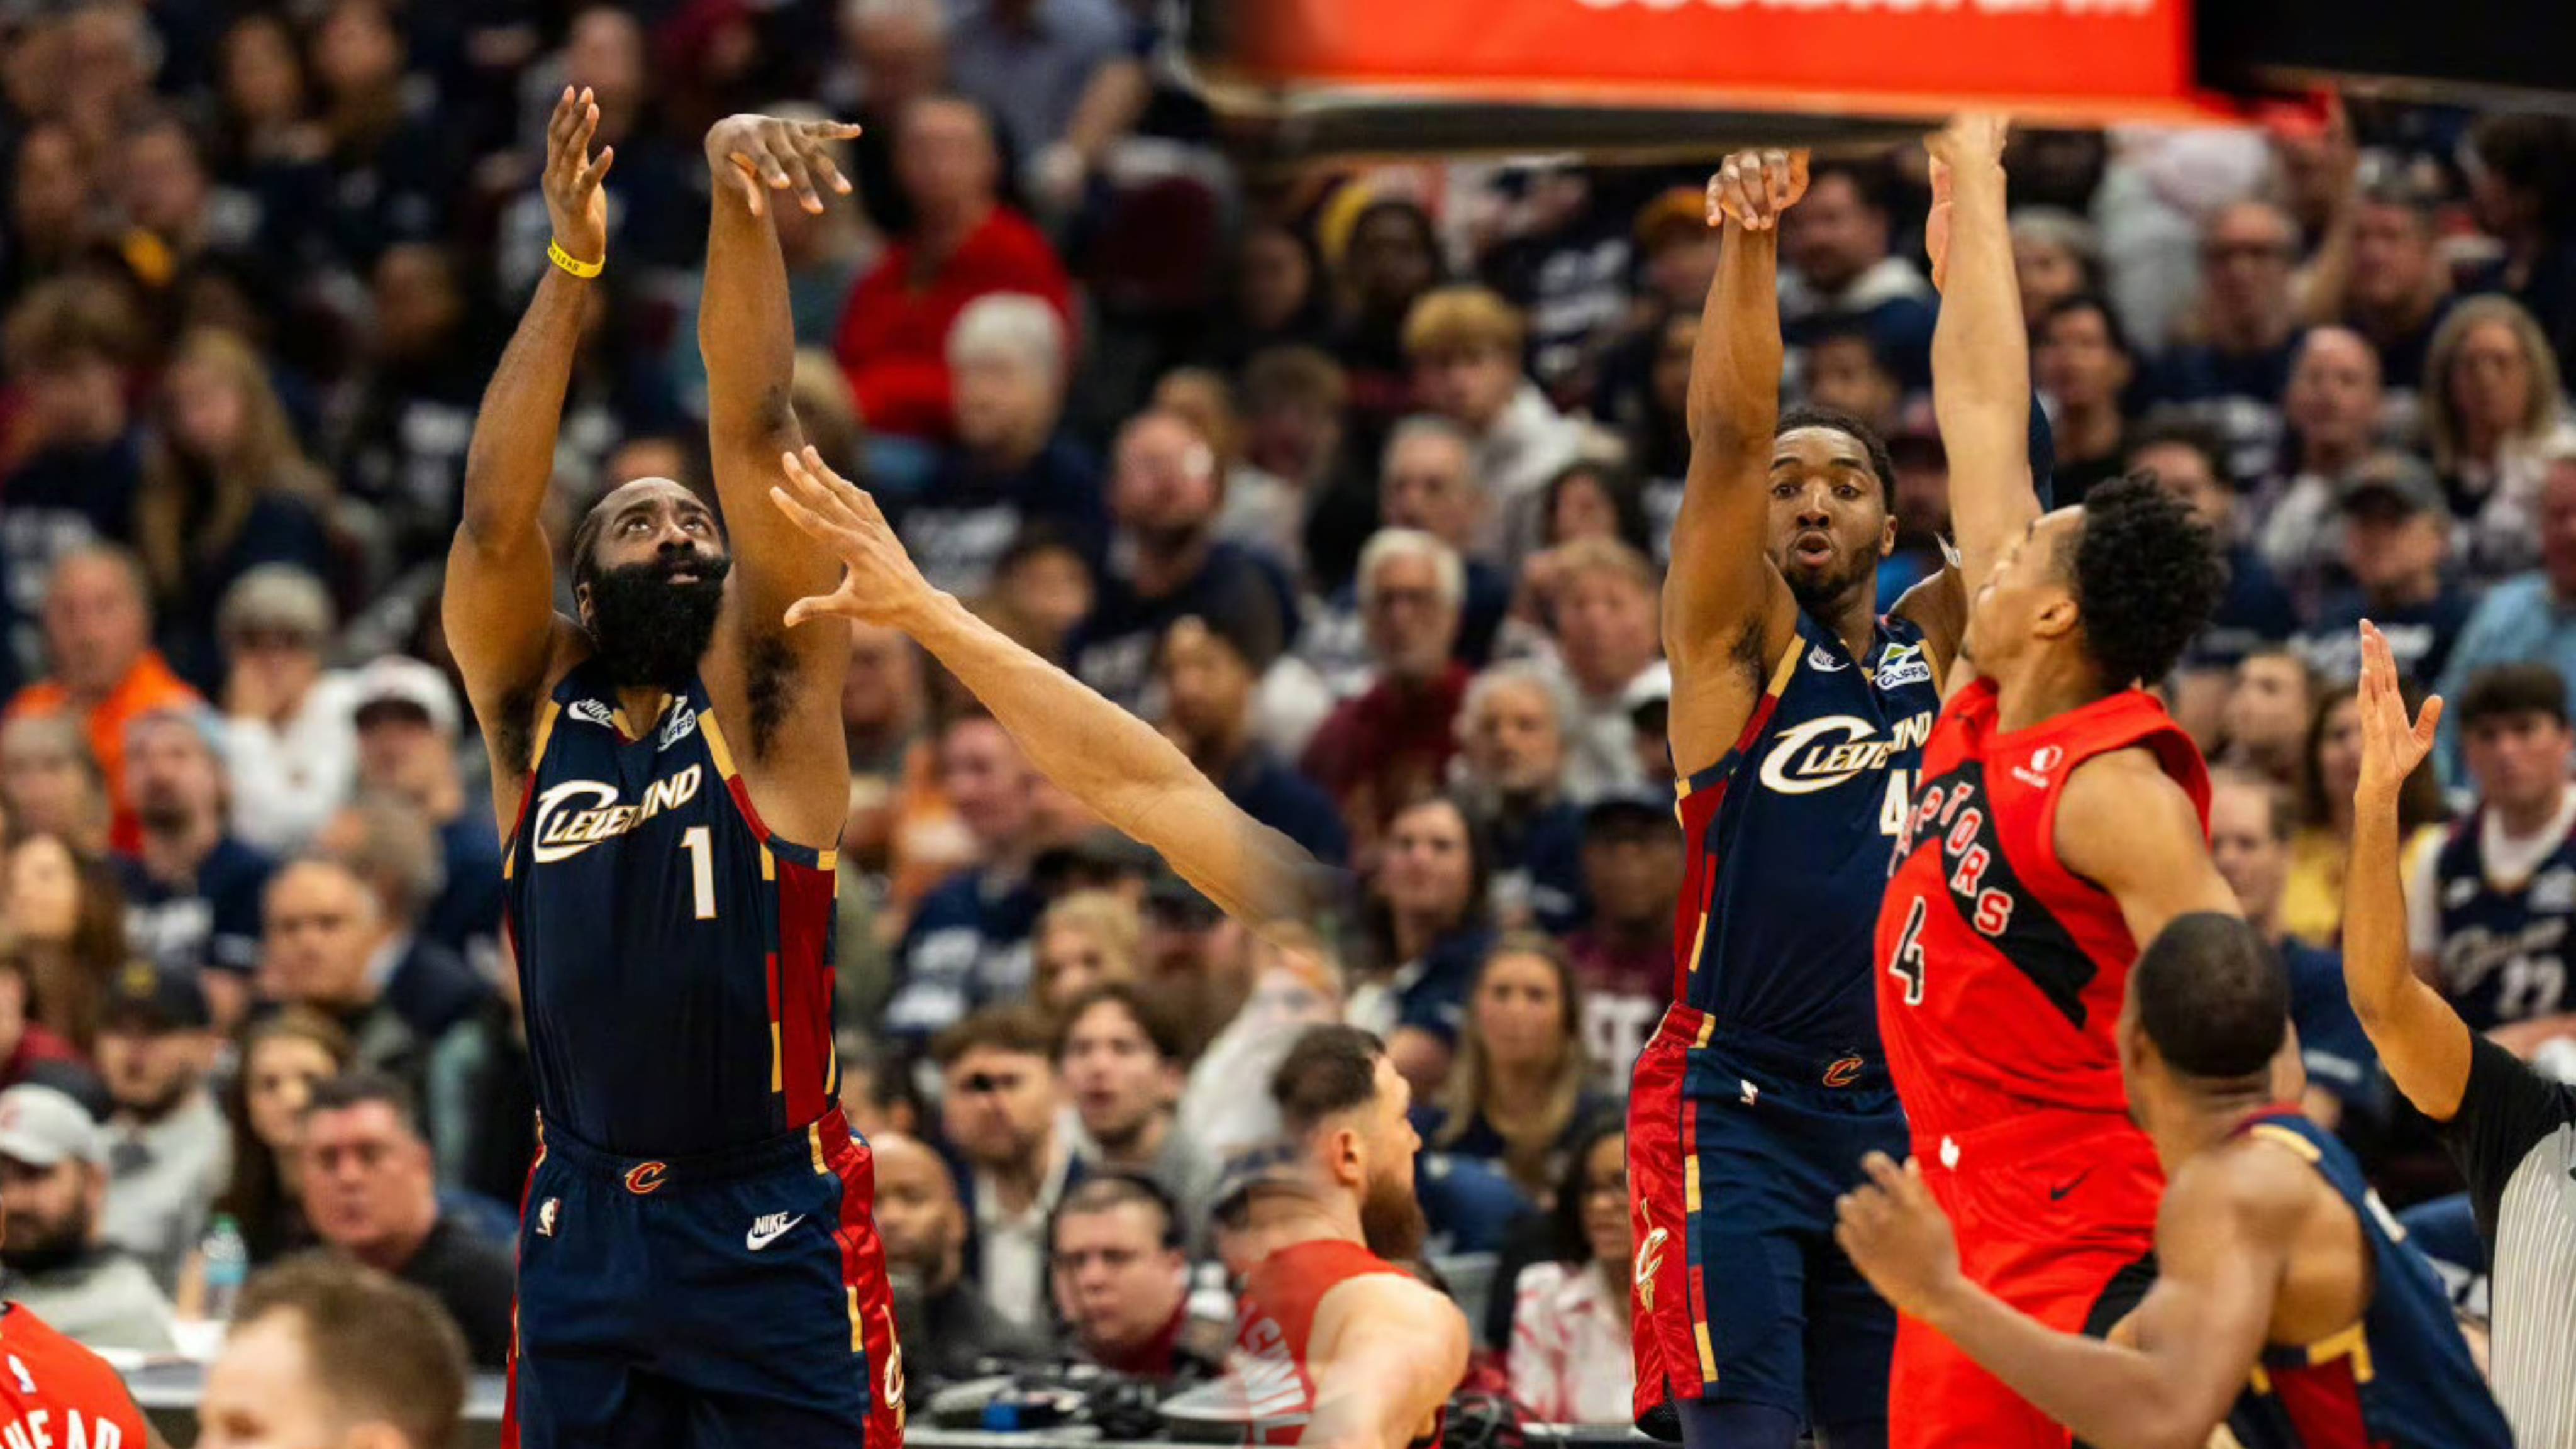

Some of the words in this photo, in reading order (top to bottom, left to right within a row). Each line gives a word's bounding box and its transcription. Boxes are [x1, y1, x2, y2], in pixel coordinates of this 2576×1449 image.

[1879, 769, 1924, 835] 4
[680, 826, 718, 921] 1
[1887, 782, 2012, 937] APTORS
[1889, 895, 1927, 1006] 4
[753, 1210, 789, 1235] NIKE
[0, 1408, 123, 1449] HEAD
